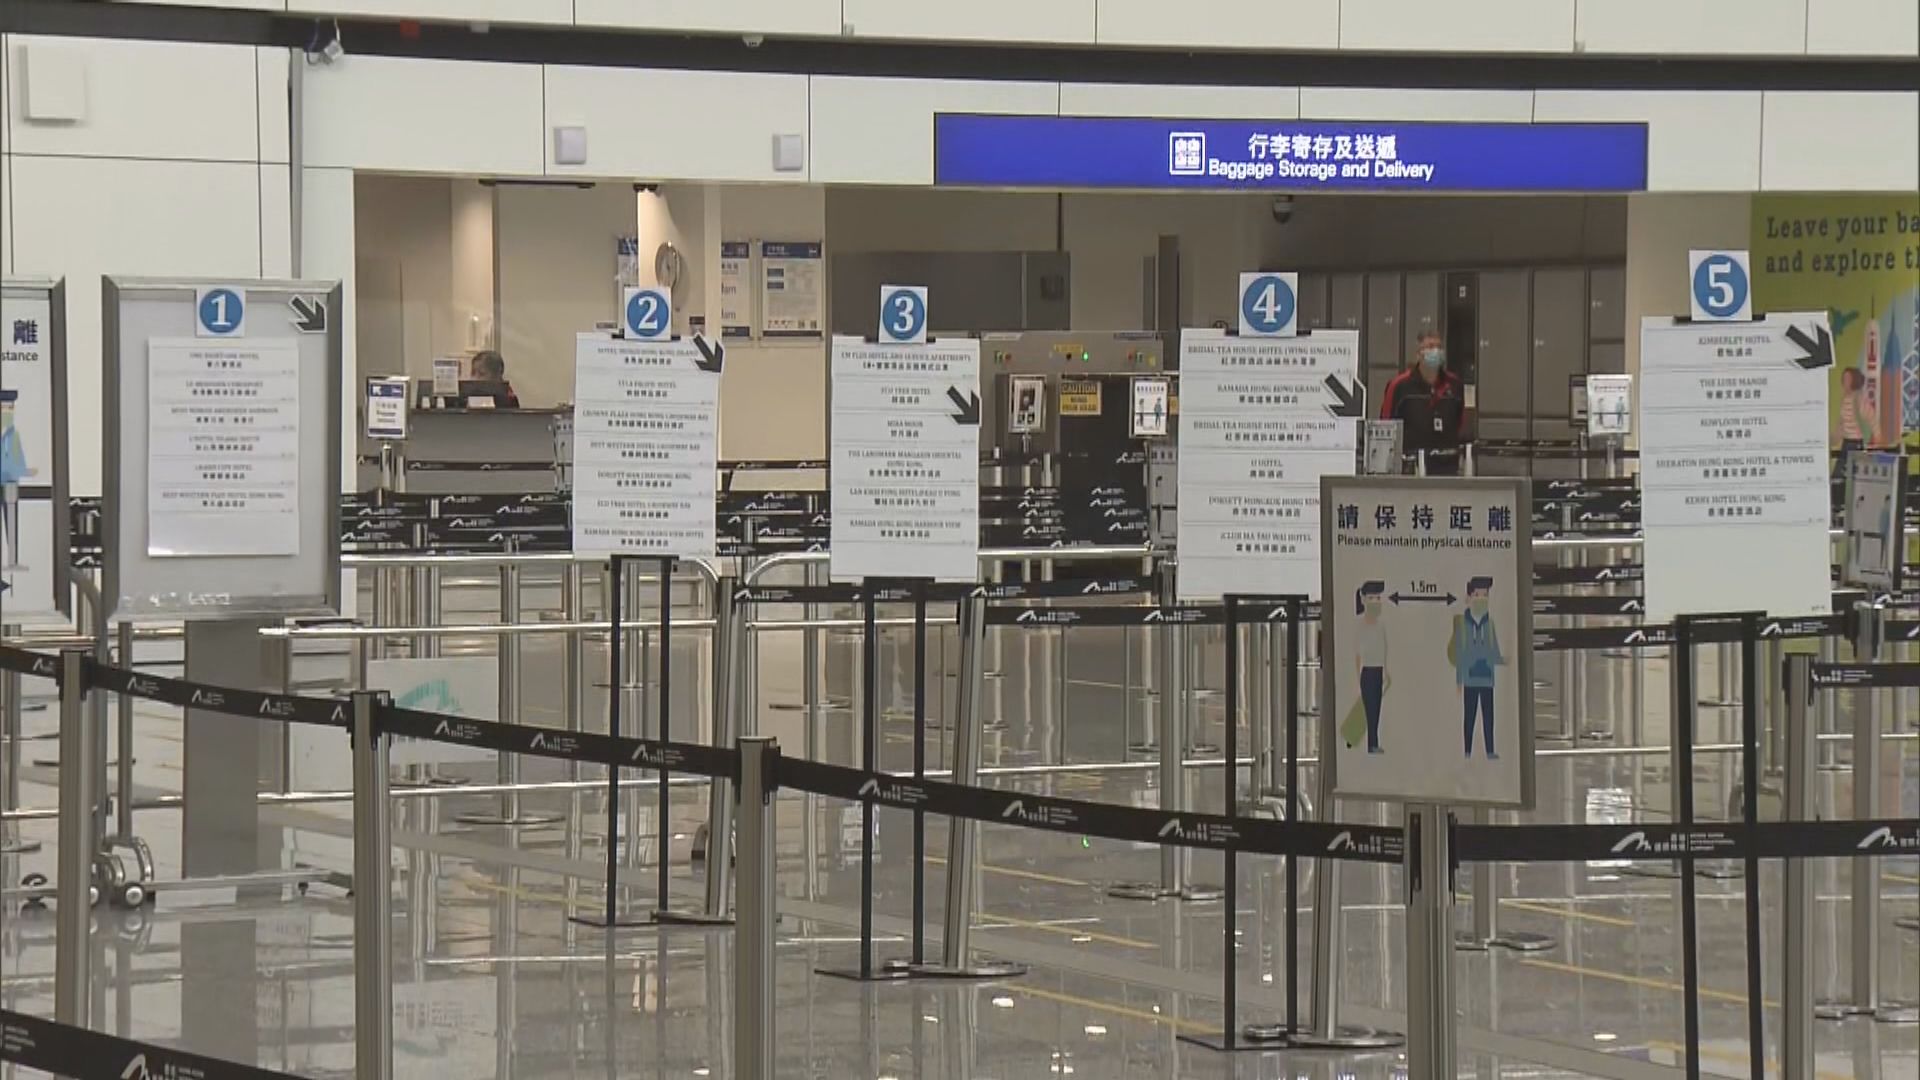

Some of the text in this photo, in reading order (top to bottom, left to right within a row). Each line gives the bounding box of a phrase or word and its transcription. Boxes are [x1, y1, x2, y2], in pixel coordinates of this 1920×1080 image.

[1248, 134, 1396, 160] 行李寄存及送遞
[1209, 159, 1434, 181] Baggage Storage and Delivery
[1767, 216, 1828, 238] Leave
[1836, 216, 1887, 242] your
[1766, 251, 1803, 273] and
[1812, 248, 1895, 276] explore
[1708, 261, 1734, 308] 5
[211, 294, 231, 326] 1
[637, 296, 660, 330] 2
[892, 295, 914, 333] 3
[1252, 282, 1281, 324] 4
[13, 319, 38, 345] 離
[1337, 504, 1511, 530] 請保持距離
[1338, 535, 1511, 550] Please maintain physical distance
[1411, 581, 1437, 593] 1.5m
